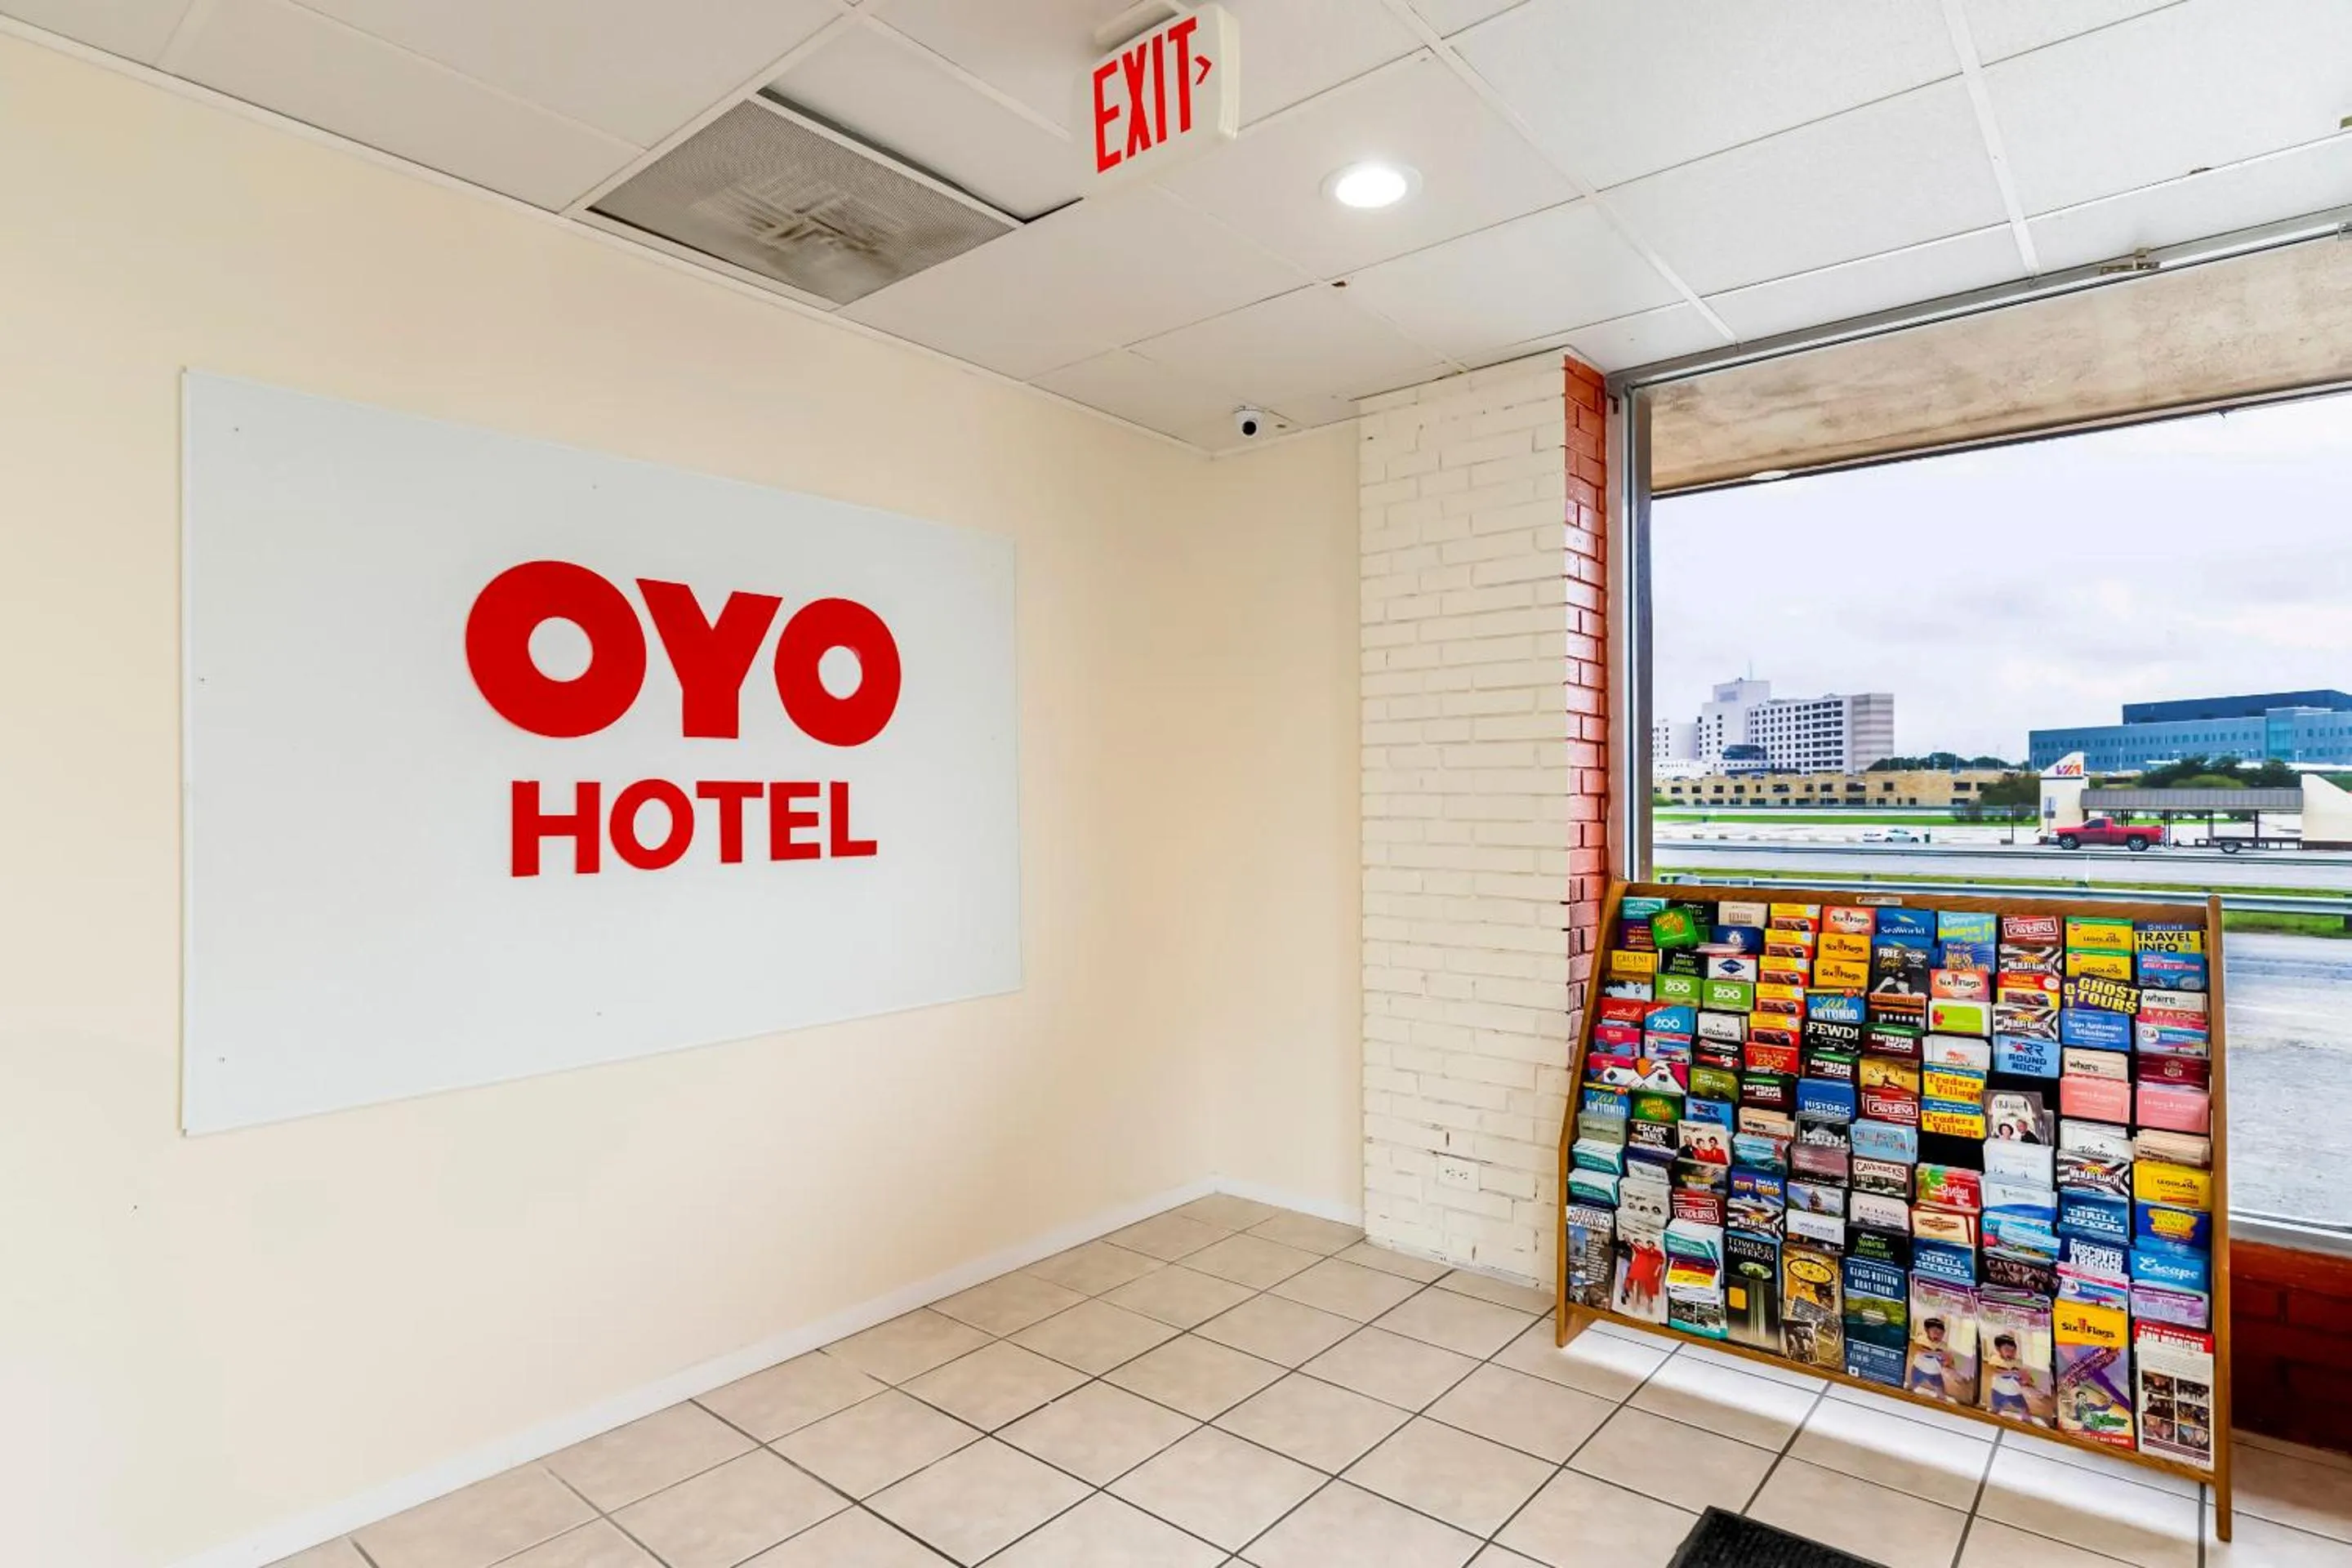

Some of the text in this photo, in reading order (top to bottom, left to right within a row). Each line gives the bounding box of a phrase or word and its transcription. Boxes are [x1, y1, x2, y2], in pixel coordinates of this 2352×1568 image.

[1093, 16, 1196, 173] EXIT
[465, 560, 902, 747] OYO
[512, 779, 877, 877] HOTEL
[1849, 916, 1869, 925] Flags
[1881, 925, 1926, 935] SeaWorld
[2136, 932, 2194, 942] TRAVEL
[1843, 945, 1864, 954] Flags
[2139, 942, 2179, 953] INFO
[1821, 969, 1861, 980] Six Flags
[1713, 987, 1741, 1000] ZOO
[2078, 978, 2140, 1001] GHOST
[2077, 989, 2138, 1014] TOURS
[2145, 995, 2176, 1004] where
[1810, 1008, 1858, 1020] ANTONIO
[1654, 1016, 1681, 1029] ZOO
[2008, 1053, 2047, 1066] ROUND
[2011, 1062, 2042, 1073] ROCK
[1927, 1073, 1977, 1088] Traders
[1804, 1100, 1851, 1114] HISTORIC
[1923, 1112, 1974, 1126] Traders
[1933, 1122, 1979, 1138] Village
[2068, 1207, 2118, 1224] THRILL
[2063, 1215, 2124, 1233] SEEKERS
[1727, 1245, 1774, 1261] AMERICAS
[2069, 1240, 2123, 1261] DISCOVER
[1914, 1259, 1971, 1278] SEEKERS
[1919, 1252, 1966, 1270] THRILL
[2139, 1256, 2199, 1280] Escape
[1986, 1259, 2049, 1283] CAVERNS
[2060, 1321, 2115, 1339] Six Flags
[2140, 1330, 2206, 1352] SAN MARCOS
